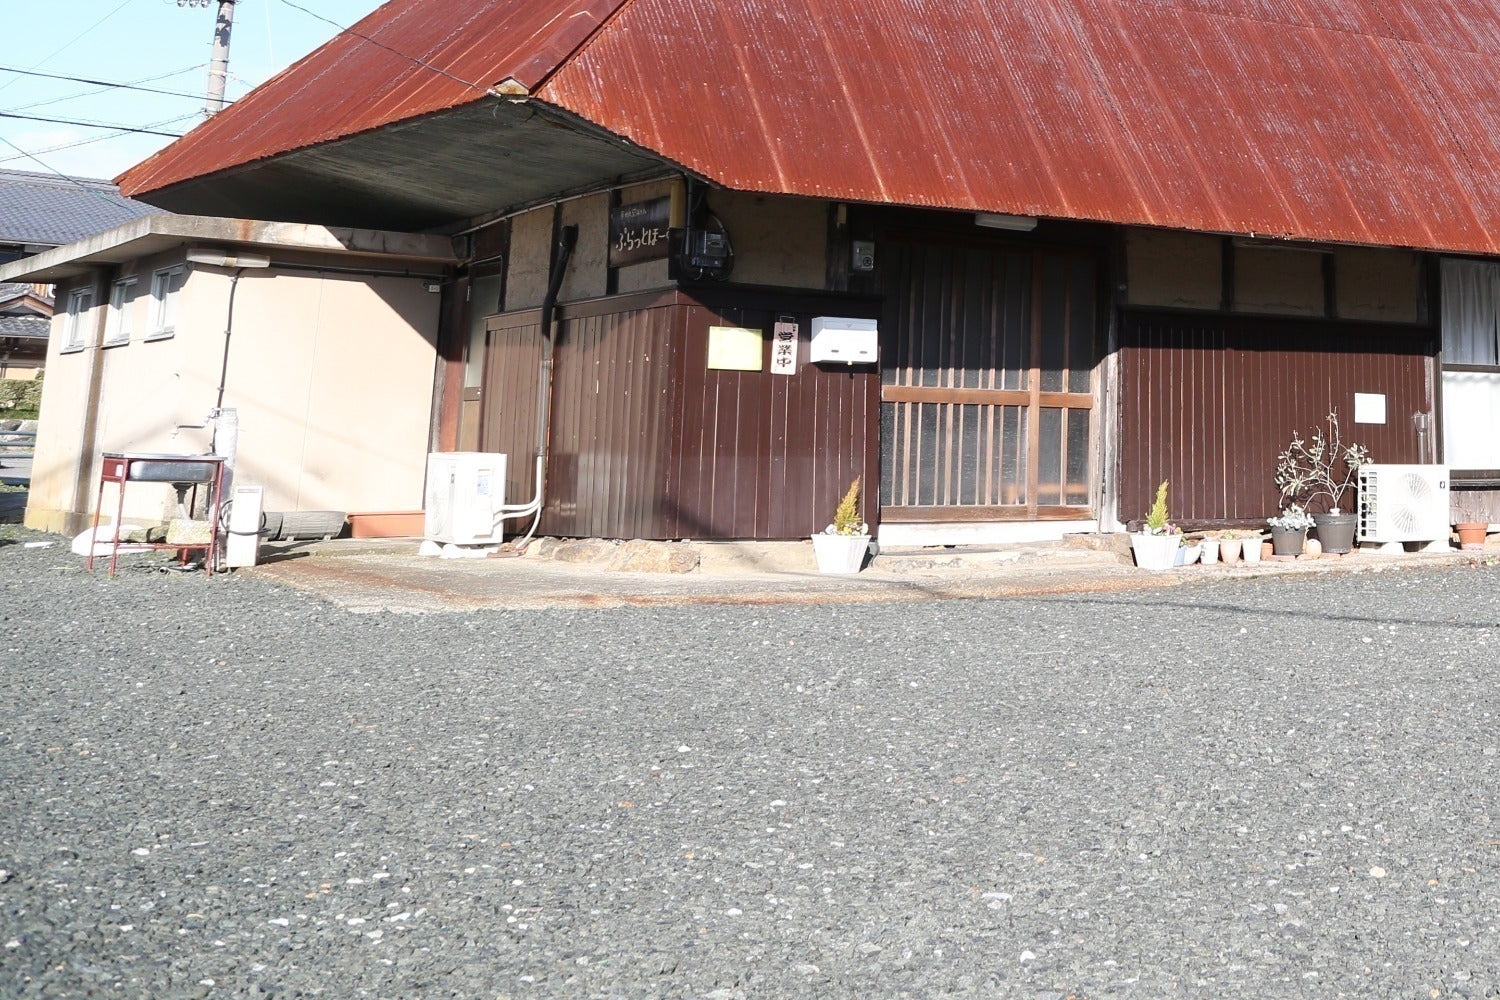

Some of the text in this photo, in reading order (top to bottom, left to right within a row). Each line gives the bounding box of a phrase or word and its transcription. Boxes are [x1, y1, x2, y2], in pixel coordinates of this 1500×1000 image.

[615, 226, 669, 252] ぷらっとほー
[777, 331, 794, 368] 営業中
